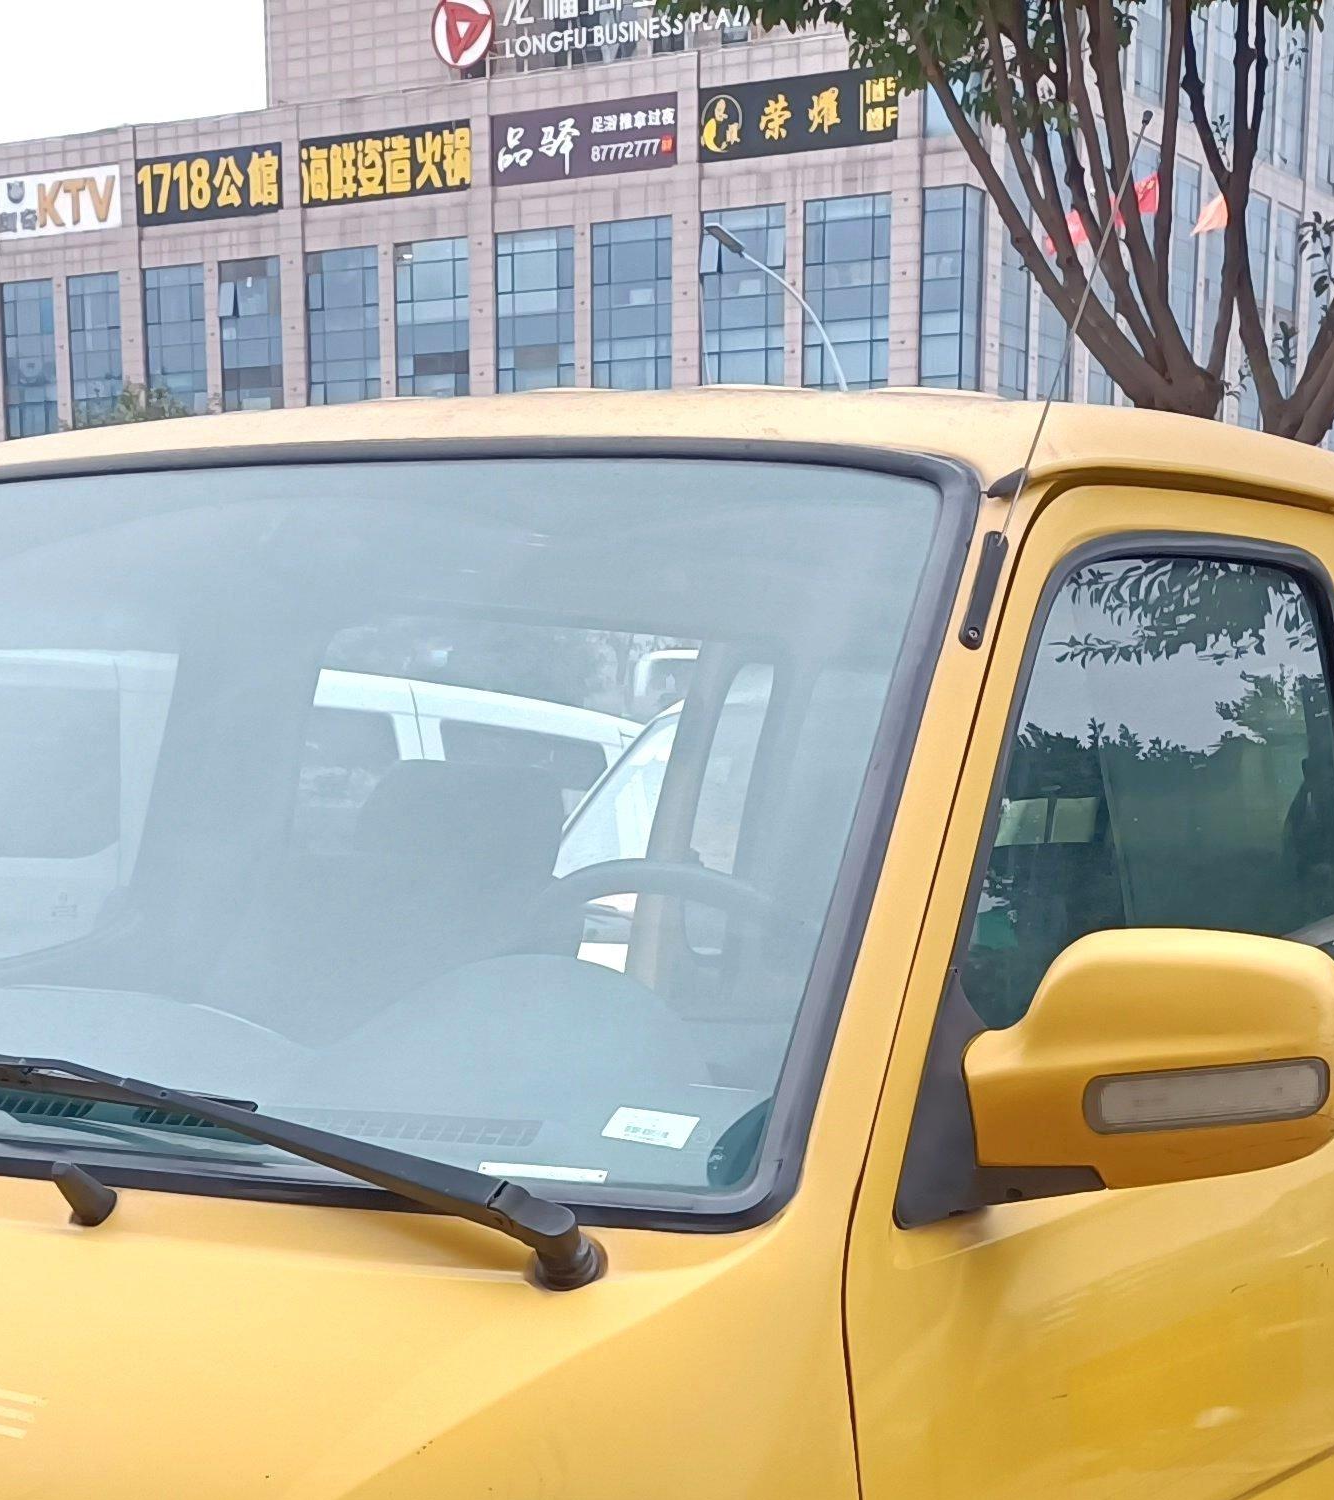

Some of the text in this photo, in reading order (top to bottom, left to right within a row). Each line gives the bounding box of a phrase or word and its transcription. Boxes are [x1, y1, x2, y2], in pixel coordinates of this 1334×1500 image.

[504, 26, 586, 59] LONGFU
[593, 13, 683, 47] BUSINESS
[591, 138, 661, 162] 87772777
[37, 174, 116, 228] KTV
